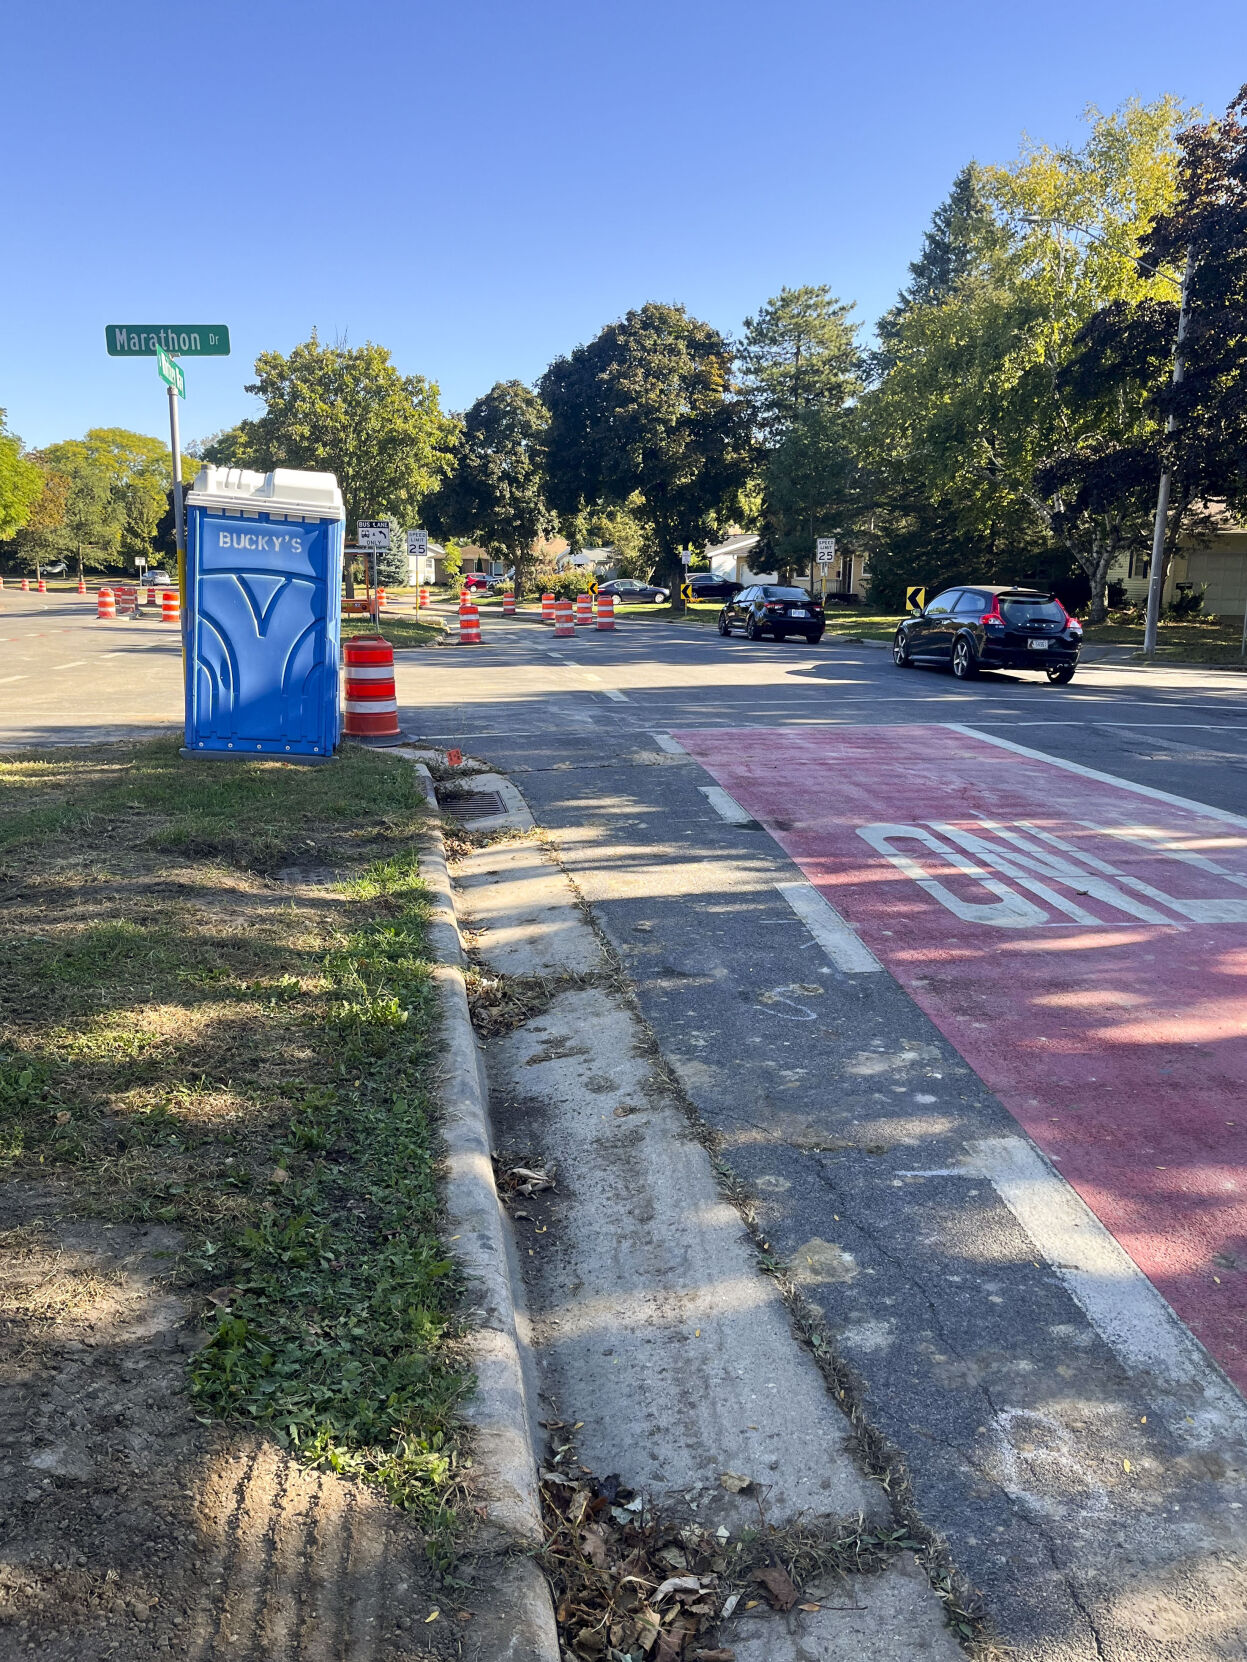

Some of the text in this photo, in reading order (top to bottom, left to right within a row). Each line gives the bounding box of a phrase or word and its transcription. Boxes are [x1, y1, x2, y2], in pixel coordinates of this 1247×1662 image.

[115, 328, 219, 350] Marathon Dr
[219, 531, 302, 552] BUCKY'S
[409, 544, 426, 554] 25
[819, 551, 833, 561] 25
